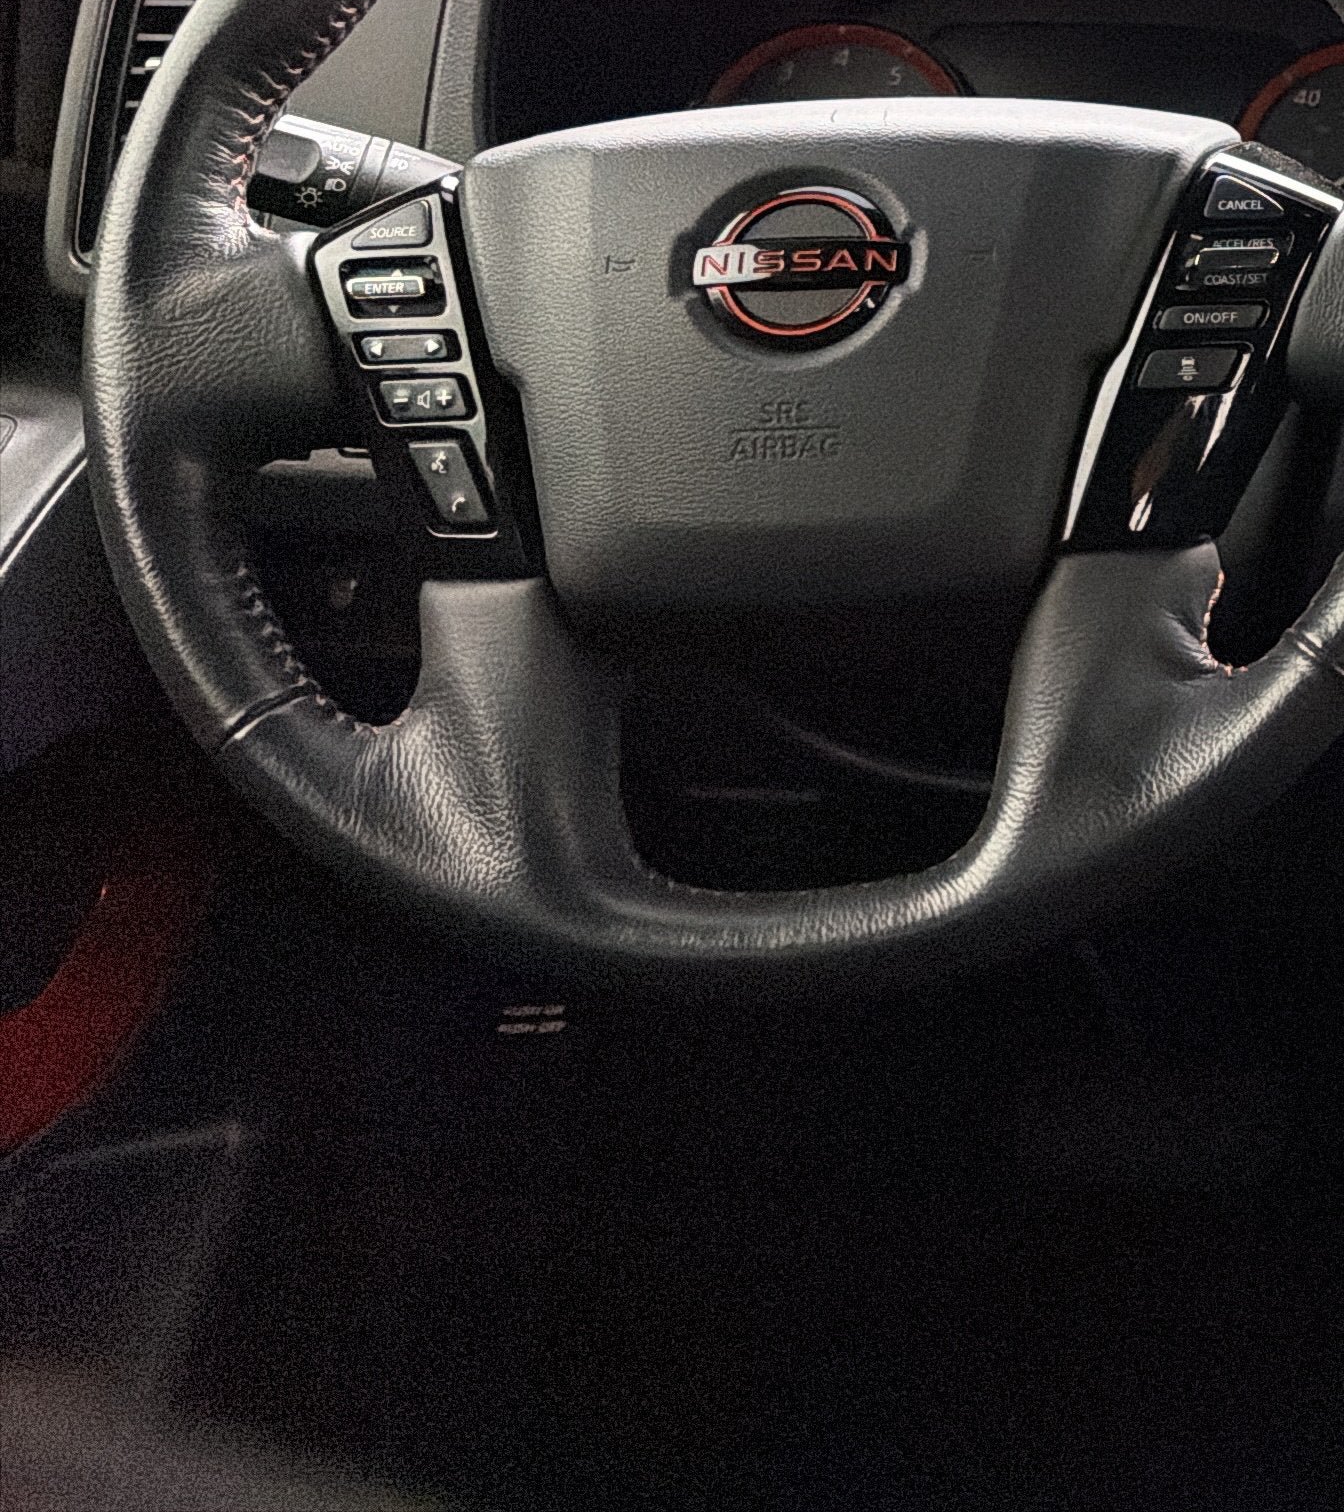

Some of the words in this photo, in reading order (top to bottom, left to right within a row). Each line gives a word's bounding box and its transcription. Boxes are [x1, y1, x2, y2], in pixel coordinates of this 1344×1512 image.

[888, 66, 902, 86] 5
[1292, 89, 1322, 107] 40
[1217, 199, 1265, 211] CANCEL
[369, 225, 417, 238] SOURCE
[700, 248, 899, 278] NISSAN
[1203, 272, 1269, 287] COAST/SET
[363, 282, 405, 295] ENTER
[1183, 311, 1240, 324] ON/OFF
[759, 401, 815, 425] SRS
[730, 436, 843, 460] AIRBAG
